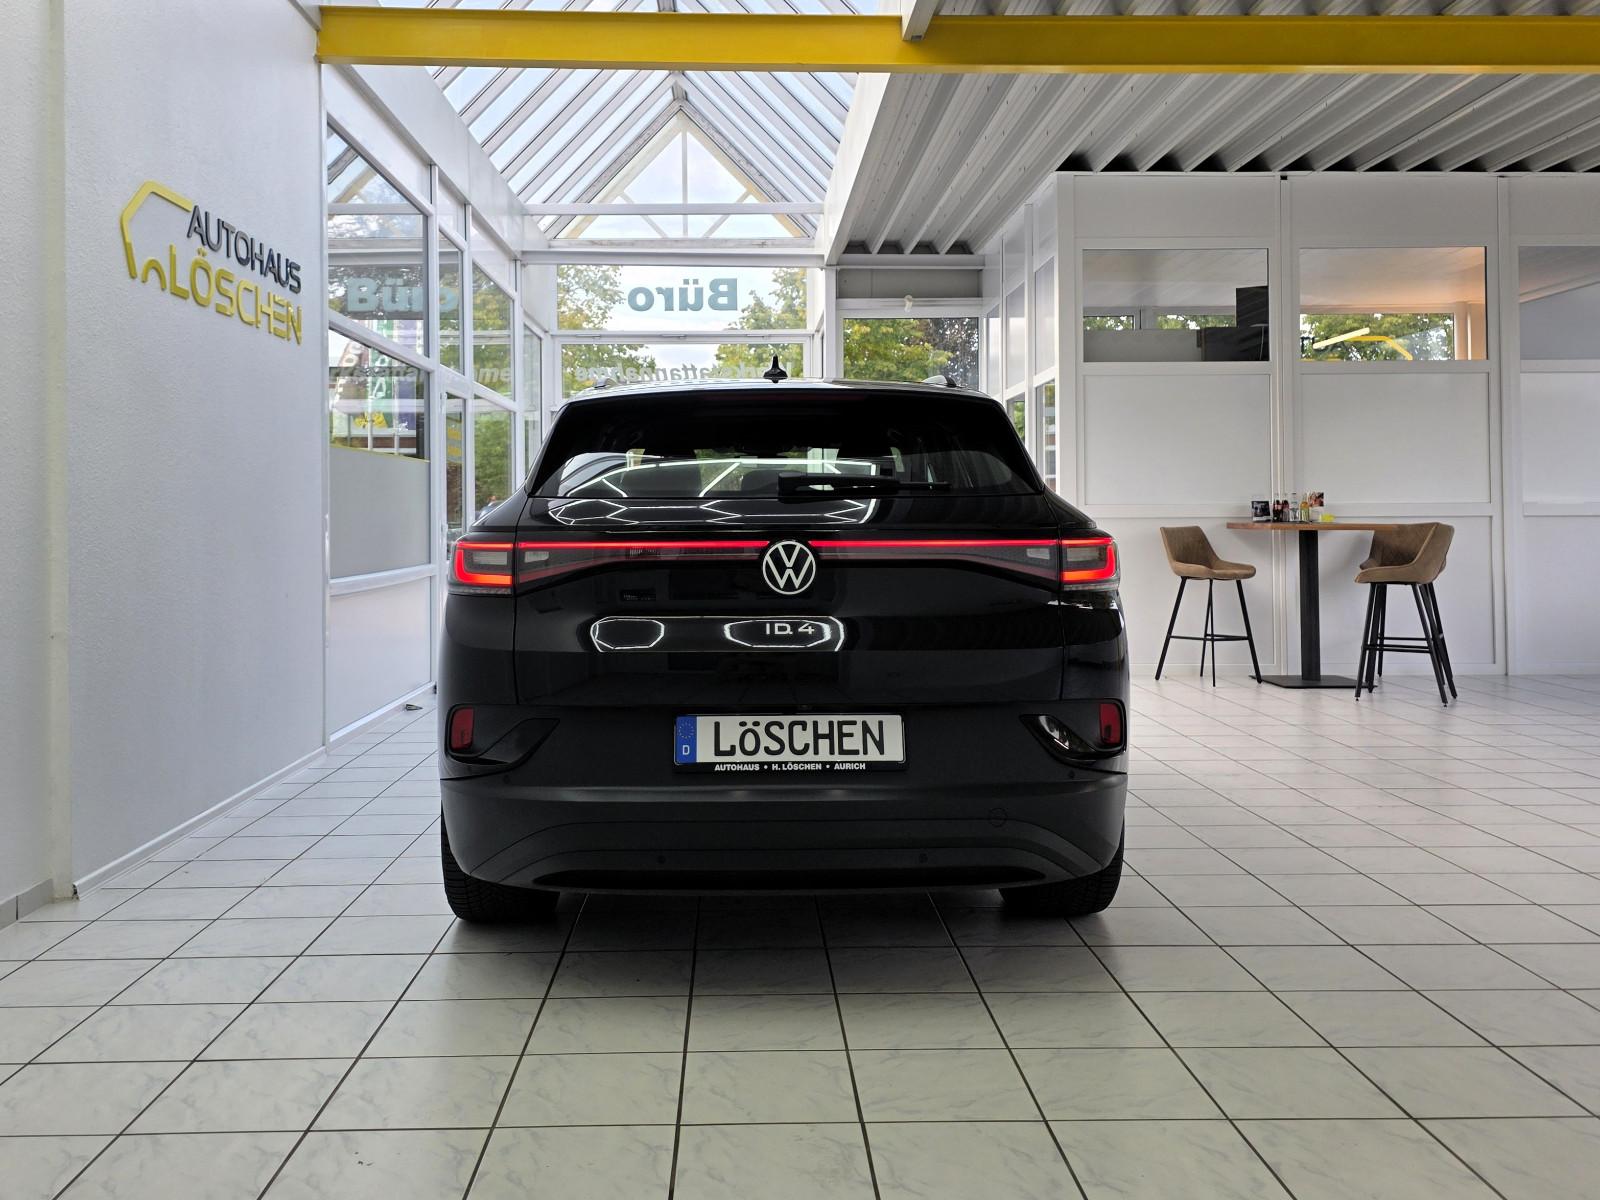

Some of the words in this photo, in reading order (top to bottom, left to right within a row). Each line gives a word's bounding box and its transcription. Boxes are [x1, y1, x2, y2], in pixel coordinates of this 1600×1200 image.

[187, 205, 302, 294] AUTOHAUS
[169, 244, 302, 346] LÖSCHEN
[682, 744, 690, 756] D
[714, 763, 760, 771] AUTOHAUS
[782, 762, 822, 771] LÖSCHEN
[834, 763, 866, 771] AURICH
